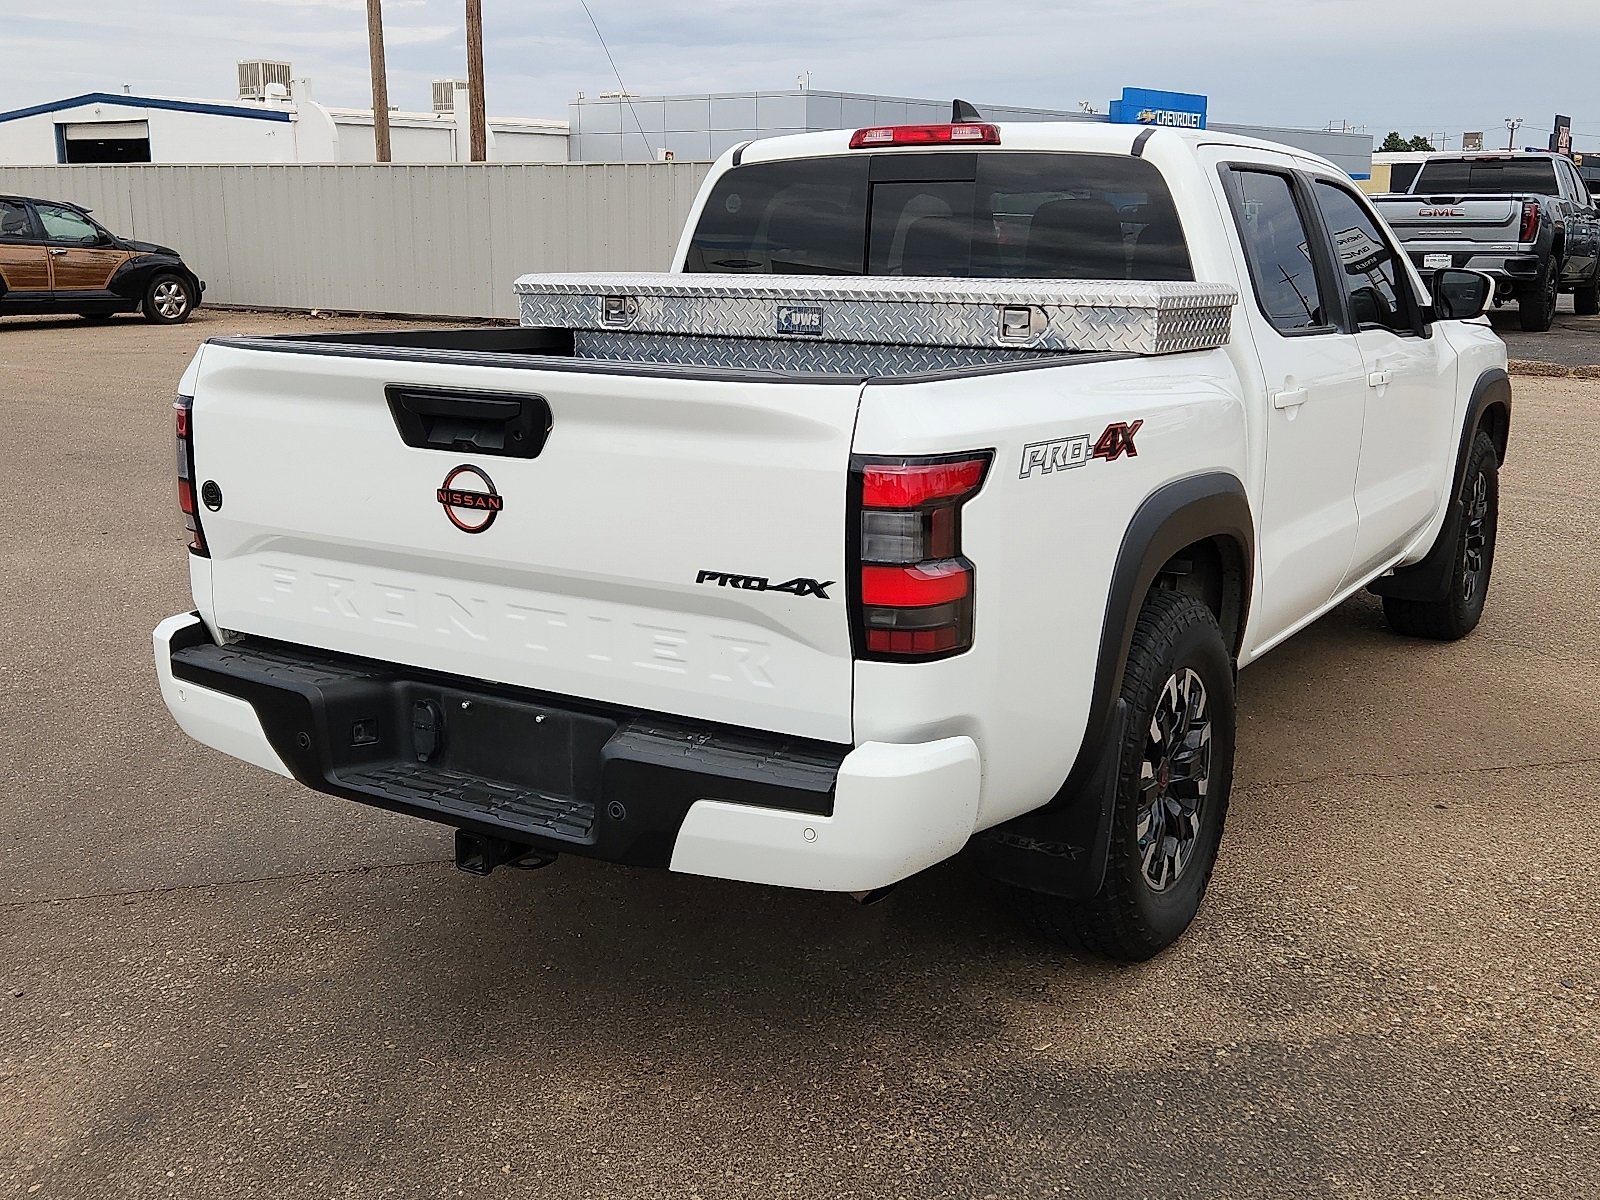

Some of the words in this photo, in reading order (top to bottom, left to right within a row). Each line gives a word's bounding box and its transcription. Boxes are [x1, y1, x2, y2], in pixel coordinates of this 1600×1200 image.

[1156, 110, 1202, 128] CHEVROLET
[1419, 207, 1465, 217] GMC
[791, 312, 820, 326] UWS
[437, 489, 500, 509] NISSAN
[695, 569, 837, 600] PRO-4X
[257, 563, 777, 689] FRONTIER
